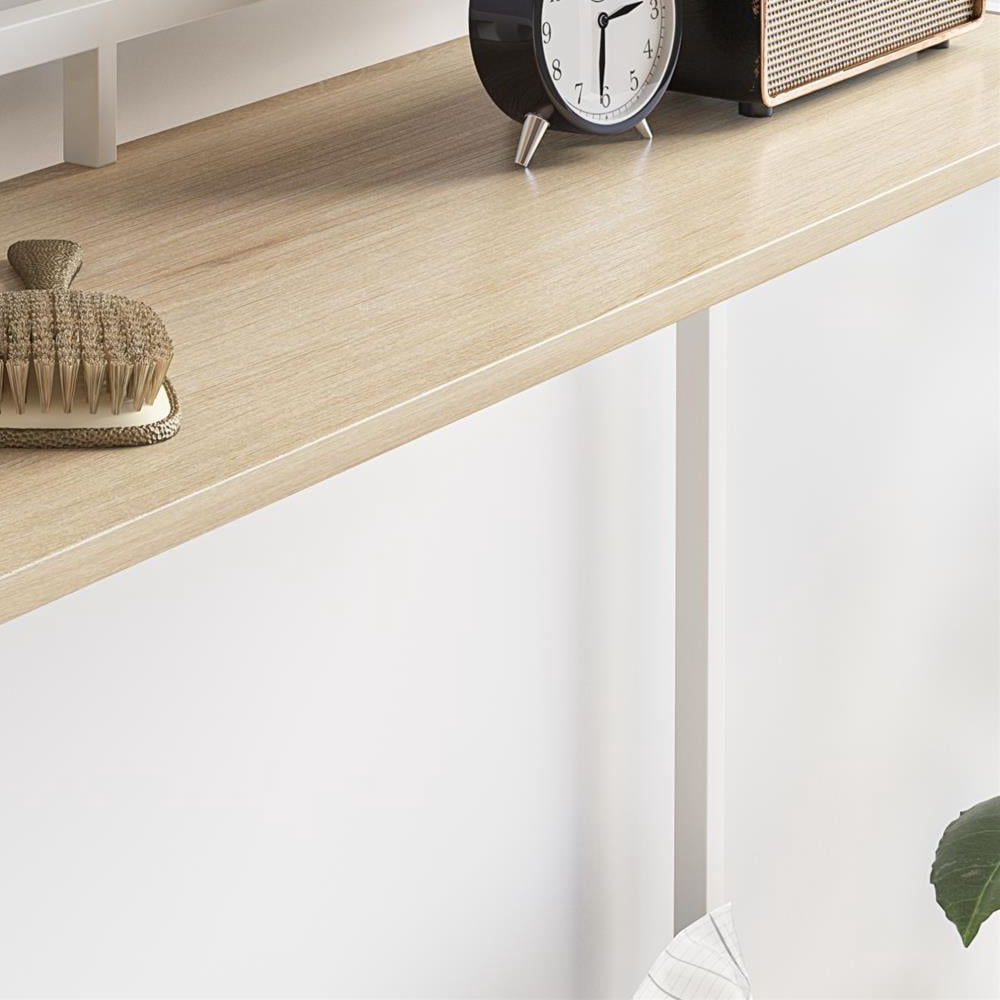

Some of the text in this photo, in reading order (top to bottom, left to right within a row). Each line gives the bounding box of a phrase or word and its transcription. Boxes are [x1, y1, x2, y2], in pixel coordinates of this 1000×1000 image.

[542, 22, 551, 44] 9
[643, 39, 654, 59] 4
[552, 58, 562, 81] 8
[629, 69, 639, 91] 5
[574, 82, 584, 105] 7
[600, 85, 611, 108] 6
